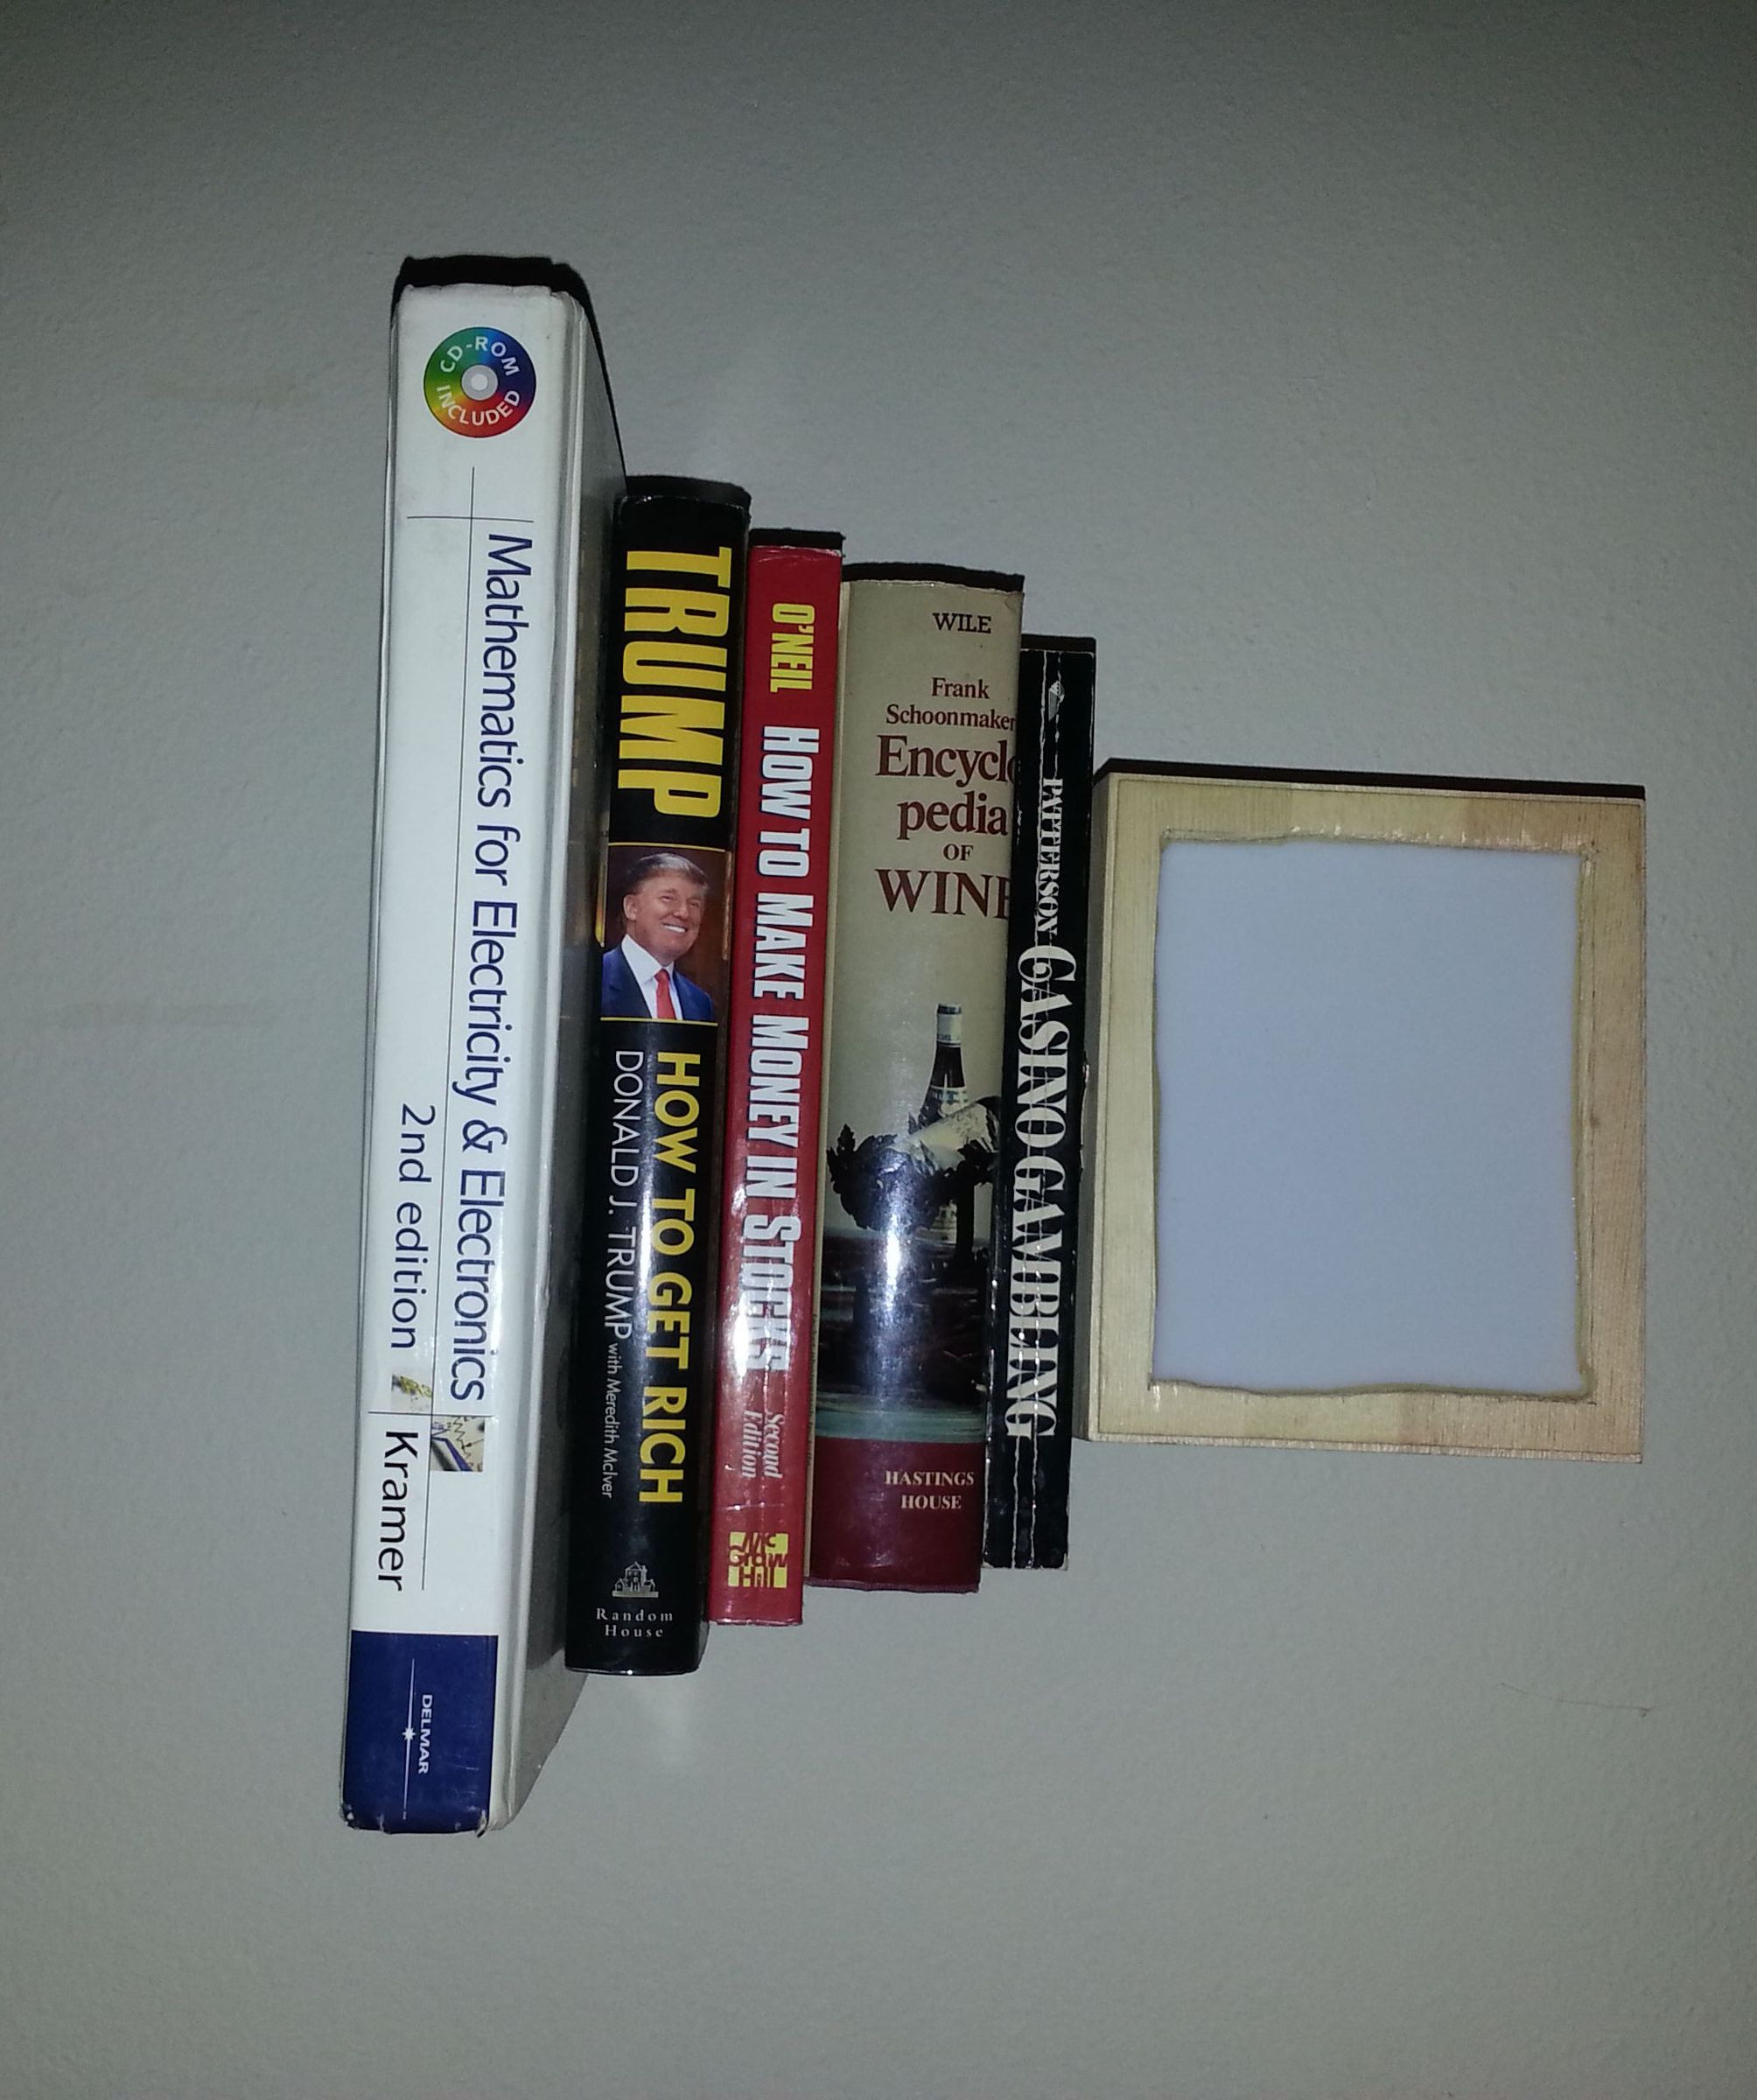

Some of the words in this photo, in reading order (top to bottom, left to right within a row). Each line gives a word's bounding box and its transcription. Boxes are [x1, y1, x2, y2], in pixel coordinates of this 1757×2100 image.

[440, 336, 520, 376] CD-ROM
[437, 385, 521, 426] INCLUDED
[770, 602, 816, 693] O'NEIL
[932, 612, 992, 634] WILE
[477, 533, 534, 808] Mathematics
[617, 546, 732, 819] TRUMP
[931, 676, 990, 699] Frank
[760, 725, 821, 821] HOW
[897, 790, 1009, 841] pedia
[474, 824, 522, 886] for
[758, 827, 811, 878] TO
[943, 843, 974, 863] OF
[1037, 778, 1064, 935] PATTERSON
[753, 891, 815, 1001] MAKE
[452, 900, 519, 1106] Electricity
[746, 1013, 810, 1149] MONEY
[1014, 944, 1077, 1150] CASINO
[398, 1102, 436, 1183] 2nd
[462, 1118, 508, 1154] &
[609, 1050, 644, 1187] DONALD
[653, 1051, 702, 1174] HOW
[608, 1194, 638, 1214] J.
[745, 1154, 799, 1200] IN
[650, 1187, 696, 1256] TO
[390, 1200, 429, 1348] edition
[450, 1167, 506, 1402] Electronics
[605, 1225, 636, 1340] TRUMP
[1004, 1154, 1068, 1438] GAMBLING
[646, 1271, 694, 1370] GET
[606, 1342, 623, 1375] with
[604, 1378, 622, 1445] Meredith
[639, 1386, 689, 1503] RICH
[741, 1409, 764, 1479] Edition
[764, 1411, 785, 1480] Second
[601, 1446, 619, 1499] McIver
[885, 1470, 975, 1487] HASTINGS
[900, 1494, 962, 1509] HOUSE
[378, 1431, 419, 1592] Kramer
[729, 1545, 788, 1567] Graw
[738, 1566, 775, 1588] Hill
[596, 1607, 673, 1621] Random
[605, 1624, 664, 1637] House
[417, 1694, 433, 1774] DELMAR
